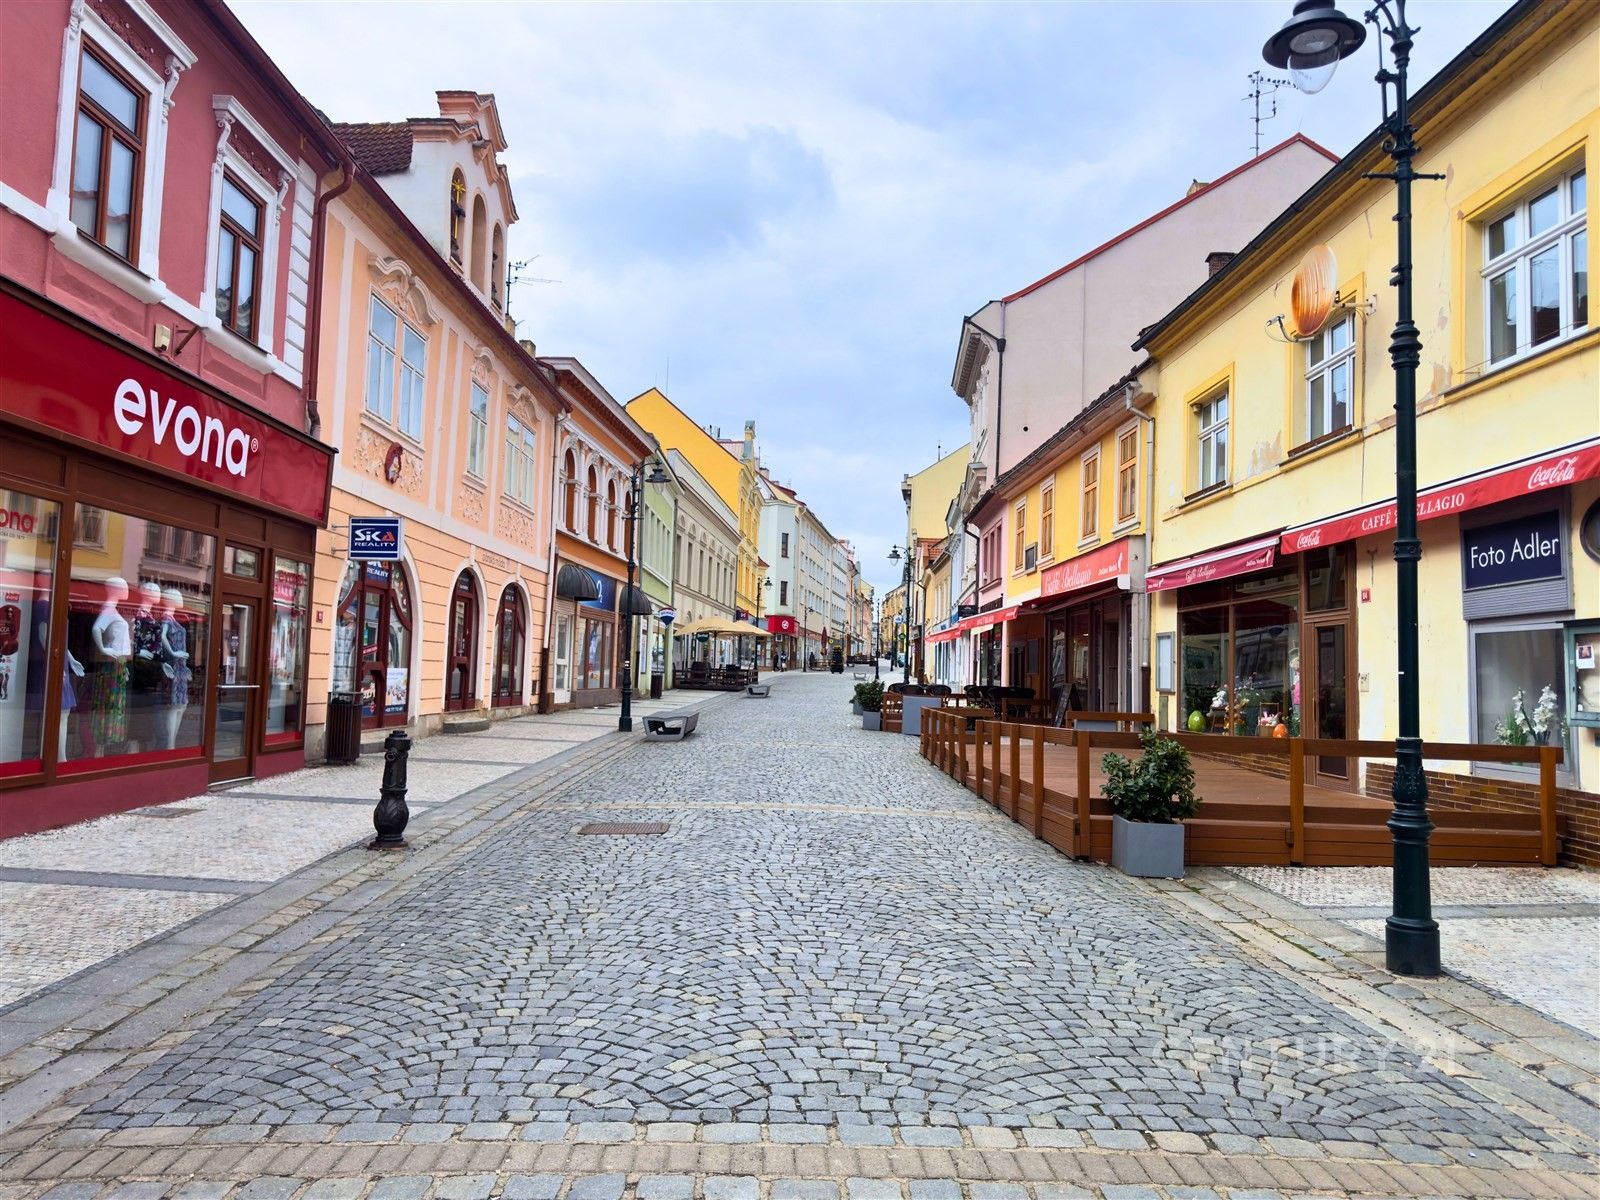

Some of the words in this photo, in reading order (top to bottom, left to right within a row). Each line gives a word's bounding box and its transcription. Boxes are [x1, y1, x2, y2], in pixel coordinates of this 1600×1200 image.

[114, 378, 249, 477] evona
[1416, 492, 1465, 517] ELLAGIO
[1471, 546, 1505, 569] Foto
[1510, 531, 1559, 563] Adler
